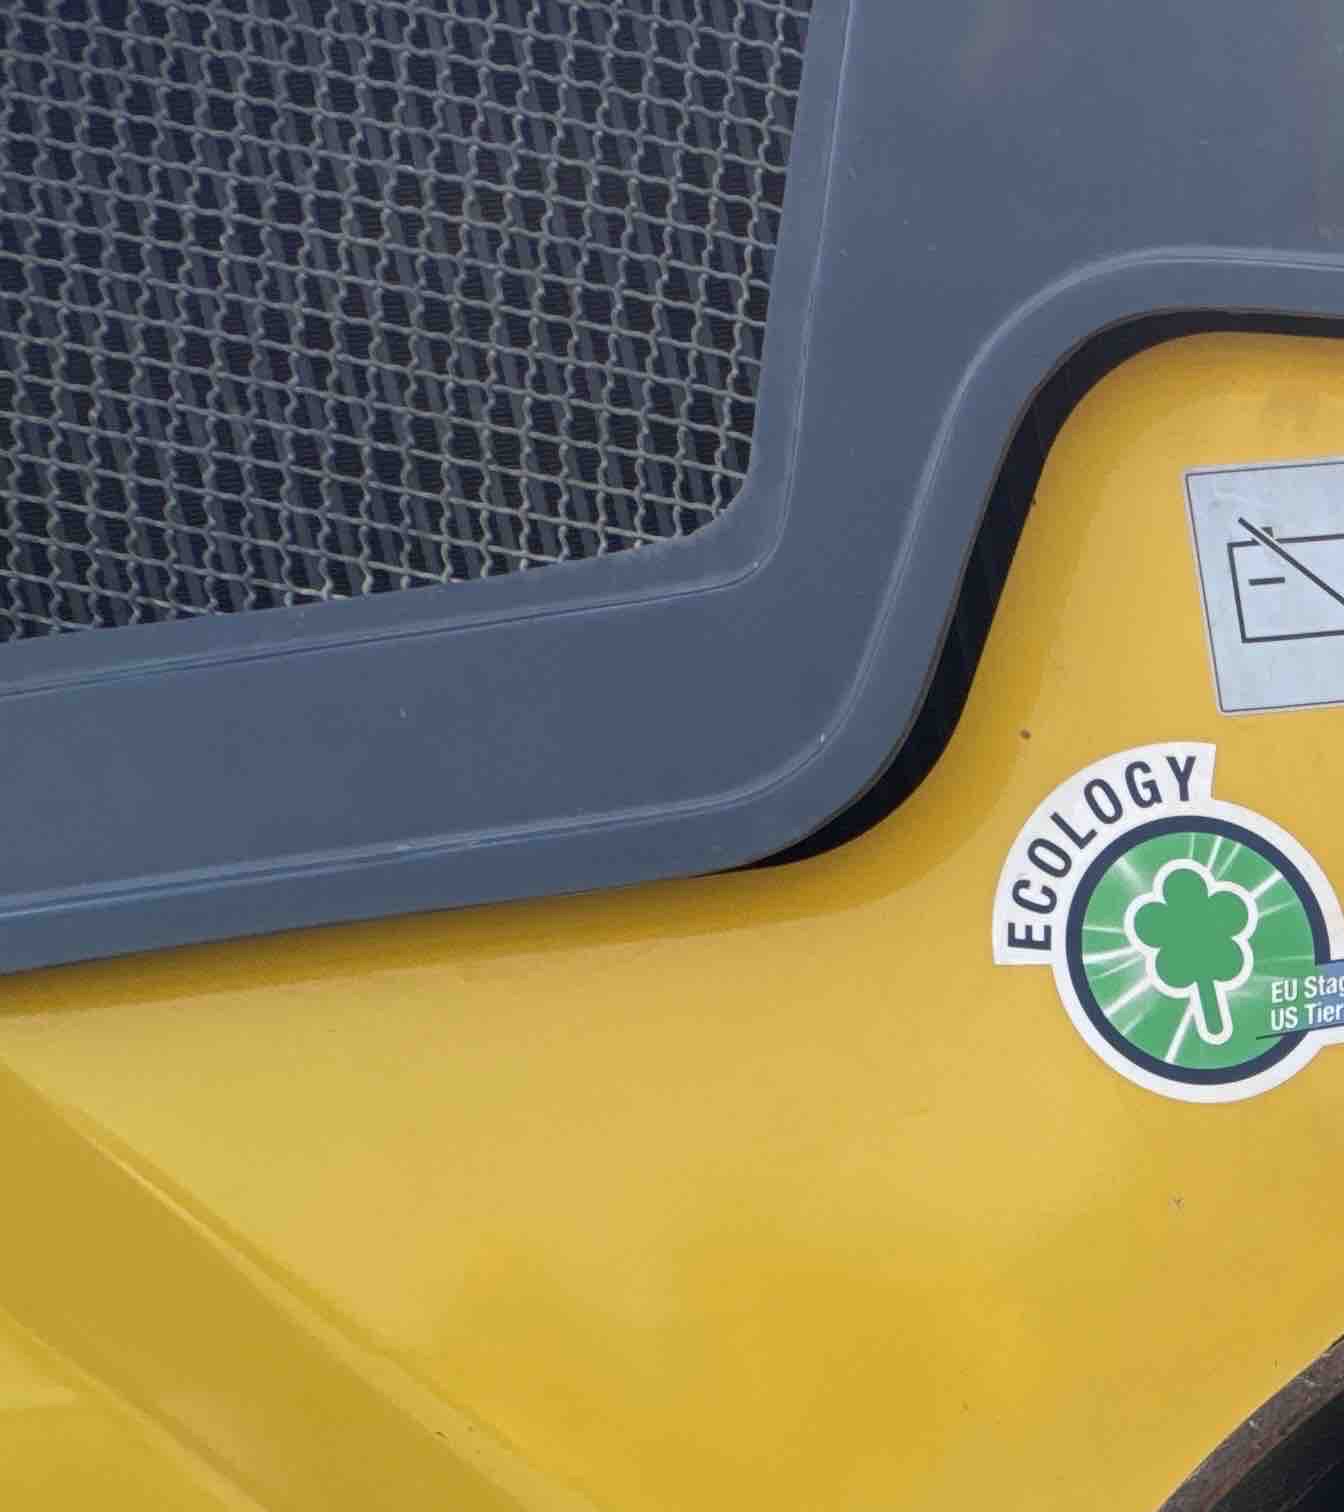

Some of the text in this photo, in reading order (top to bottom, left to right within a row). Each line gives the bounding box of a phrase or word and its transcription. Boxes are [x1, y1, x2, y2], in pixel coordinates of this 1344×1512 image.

[1007, 755, 1197, 951] ECOLOGY
[1271, 978, 1298, 1003] EU
[1271, 1006, 1298, 1031] US
[1304, 1002, 1344, 1024] Tier
